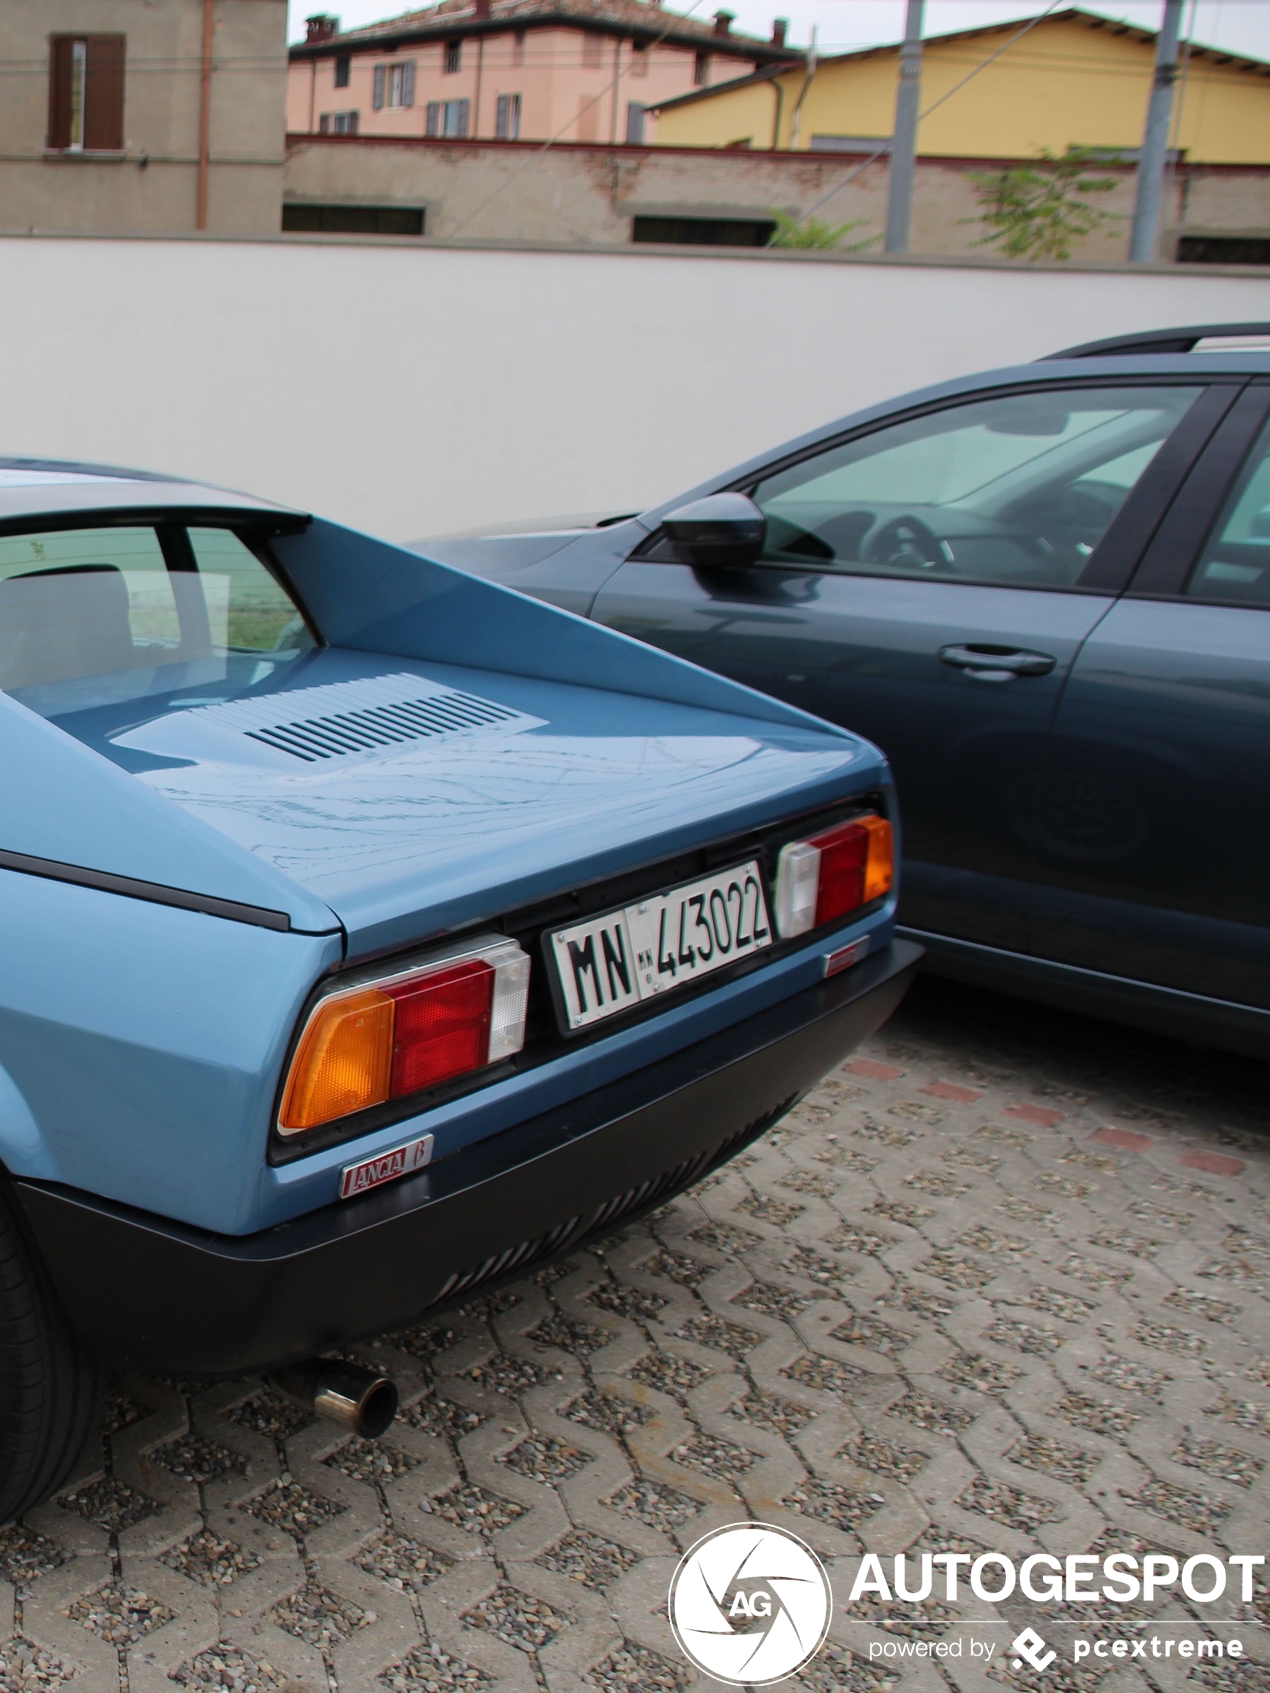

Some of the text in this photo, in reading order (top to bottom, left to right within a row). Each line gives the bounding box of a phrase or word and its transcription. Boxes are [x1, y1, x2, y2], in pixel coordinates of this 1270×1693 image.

[567, 876, 768, 1013] MN 443022
[347, 1153, 404, 1195] LANCIA
